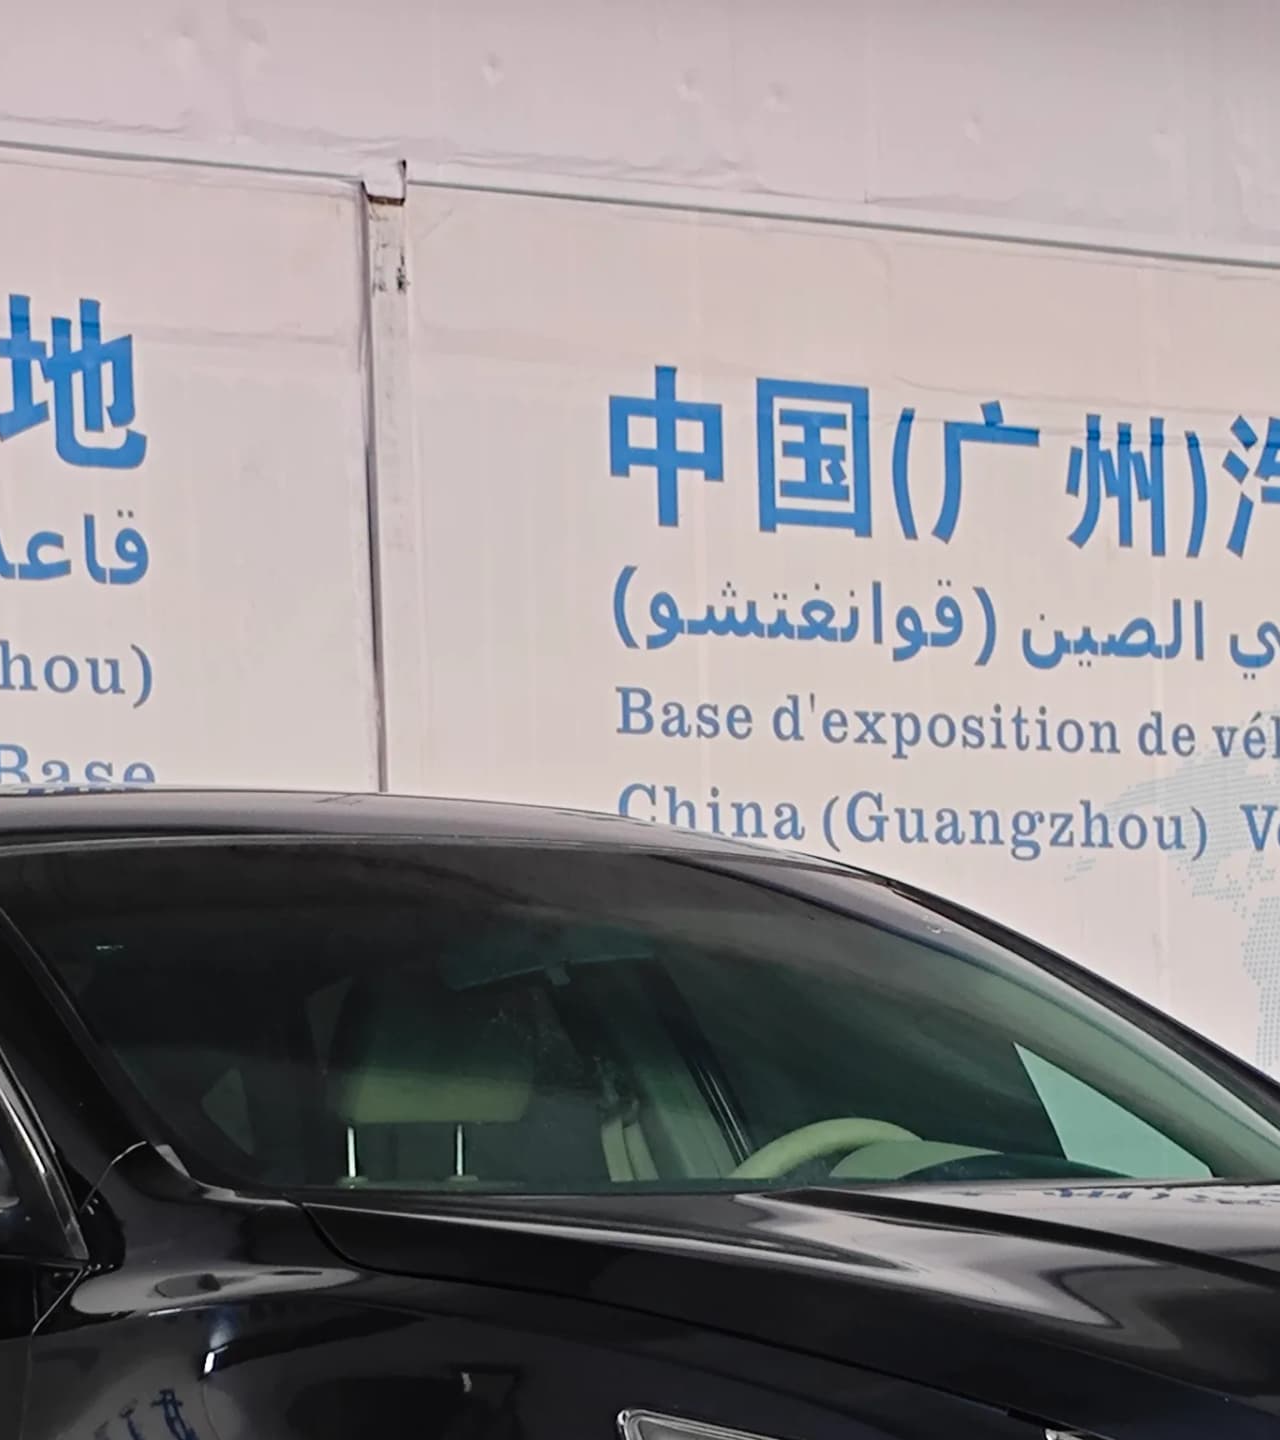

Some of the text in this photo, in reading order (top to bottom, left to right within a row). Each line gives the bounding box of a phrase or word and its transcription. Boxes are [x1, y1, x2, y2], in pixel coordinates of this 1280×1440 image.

[1021, 599, 1206, 670] الصين
[615, 686, 753, 740] Base
[771, 694, 1121, 758] d'exposition
[1138, 712, 1196, 758] de
[618, 783, 806, 841] China
[822, 791, 1210, 861] (Guangzhou)
